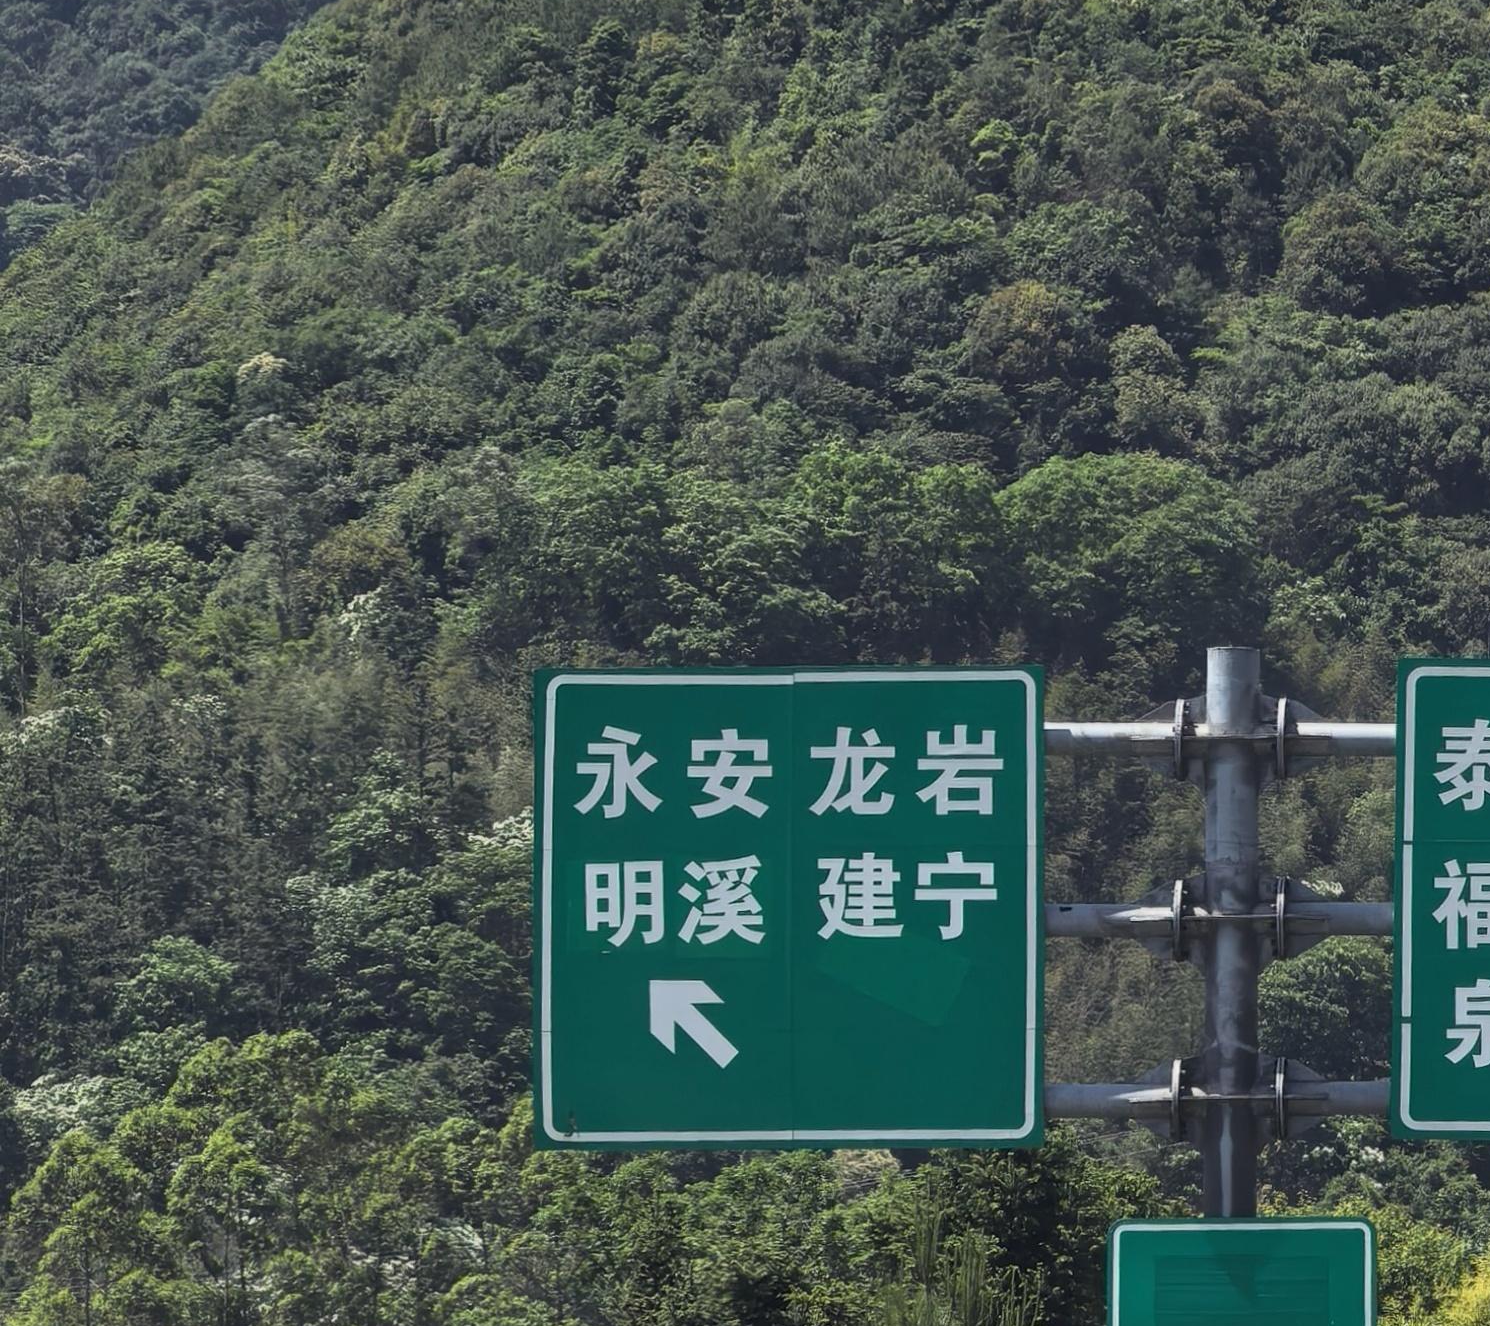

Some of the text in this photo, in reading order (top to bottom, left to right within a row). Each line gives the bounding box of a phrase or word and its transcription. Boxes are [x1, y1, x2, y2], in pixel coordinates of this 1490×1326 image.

[573, 724, 1004, 818] 永安 龙岩
[584, 852, 998, 947] 明溪 建宁
